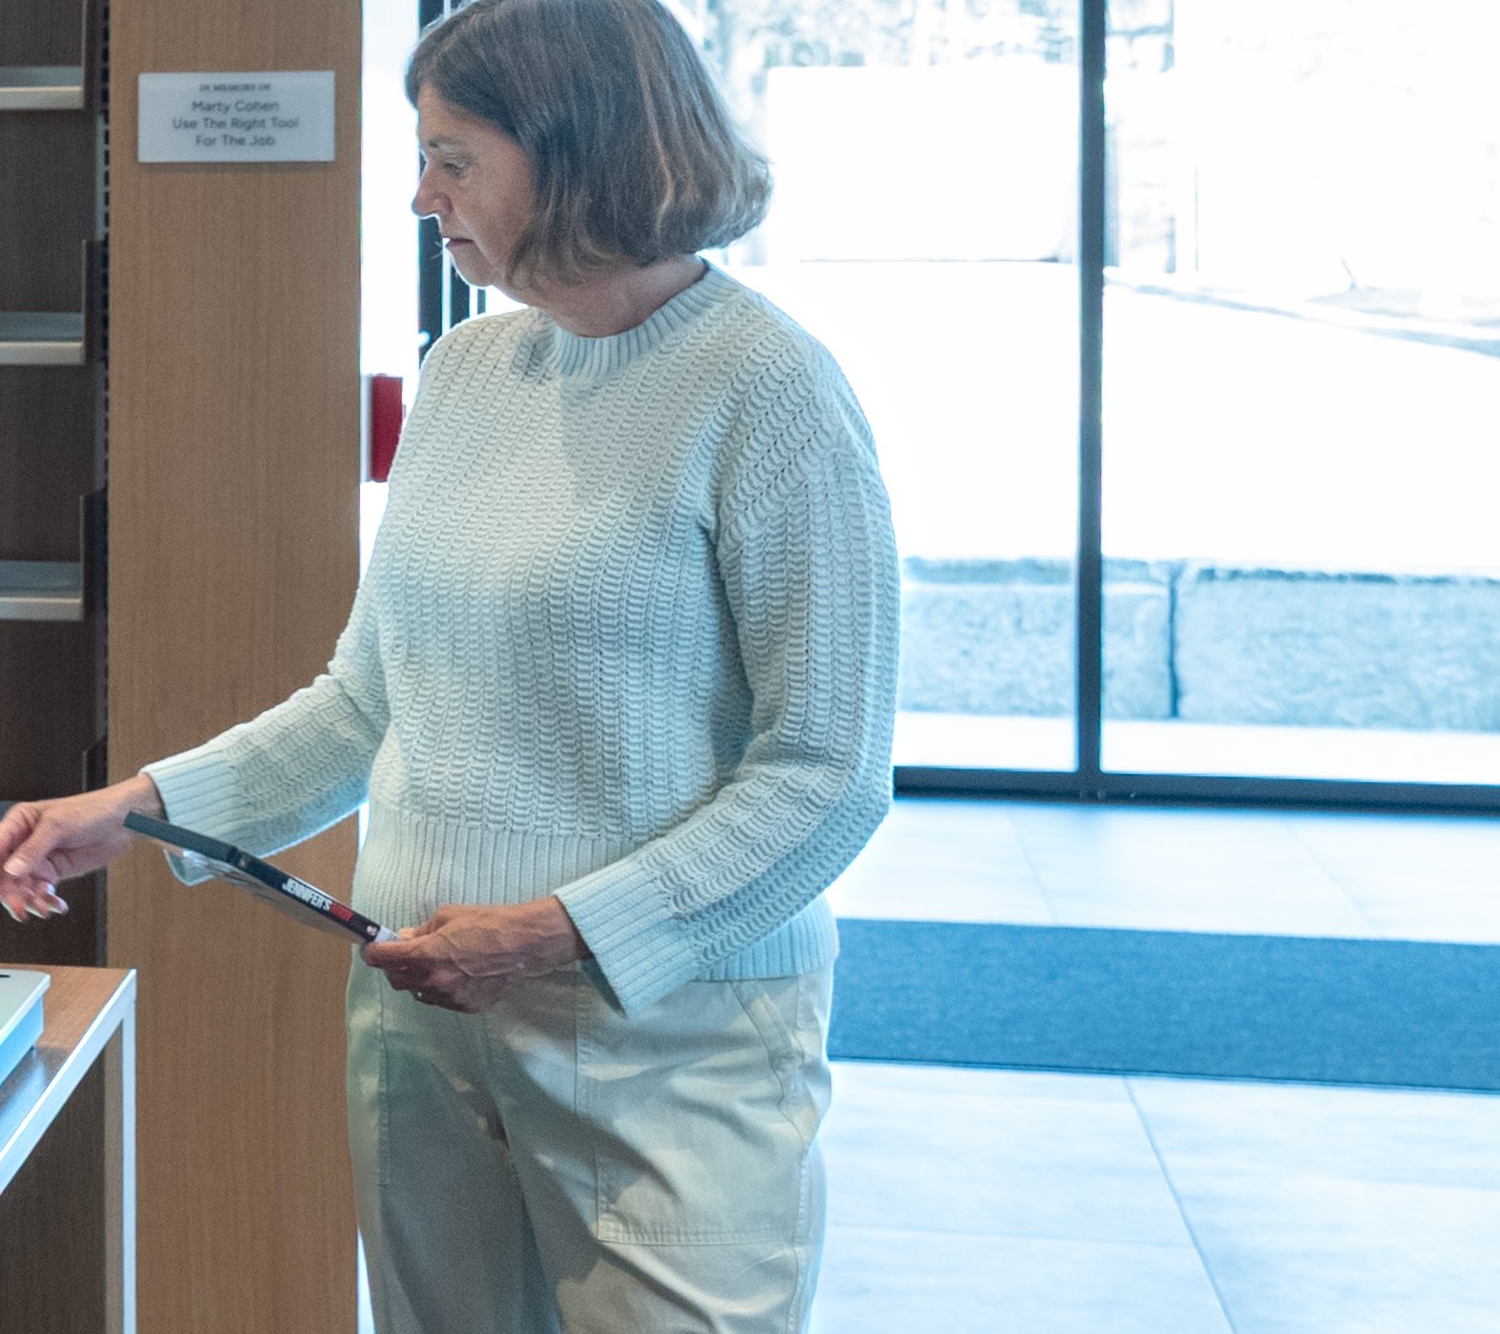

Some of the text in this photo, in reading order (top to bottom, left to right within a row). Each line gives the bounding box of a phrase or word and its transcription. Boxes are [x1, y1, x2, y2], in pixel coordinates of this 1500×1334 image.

[191, 99, 280, 115] Marty Cohen
[172, 116, 300, 132] Use The Right Tool
[195, 133, 276, 147] For The Job
[281, 877, 333, 911] JENNIFER'S
